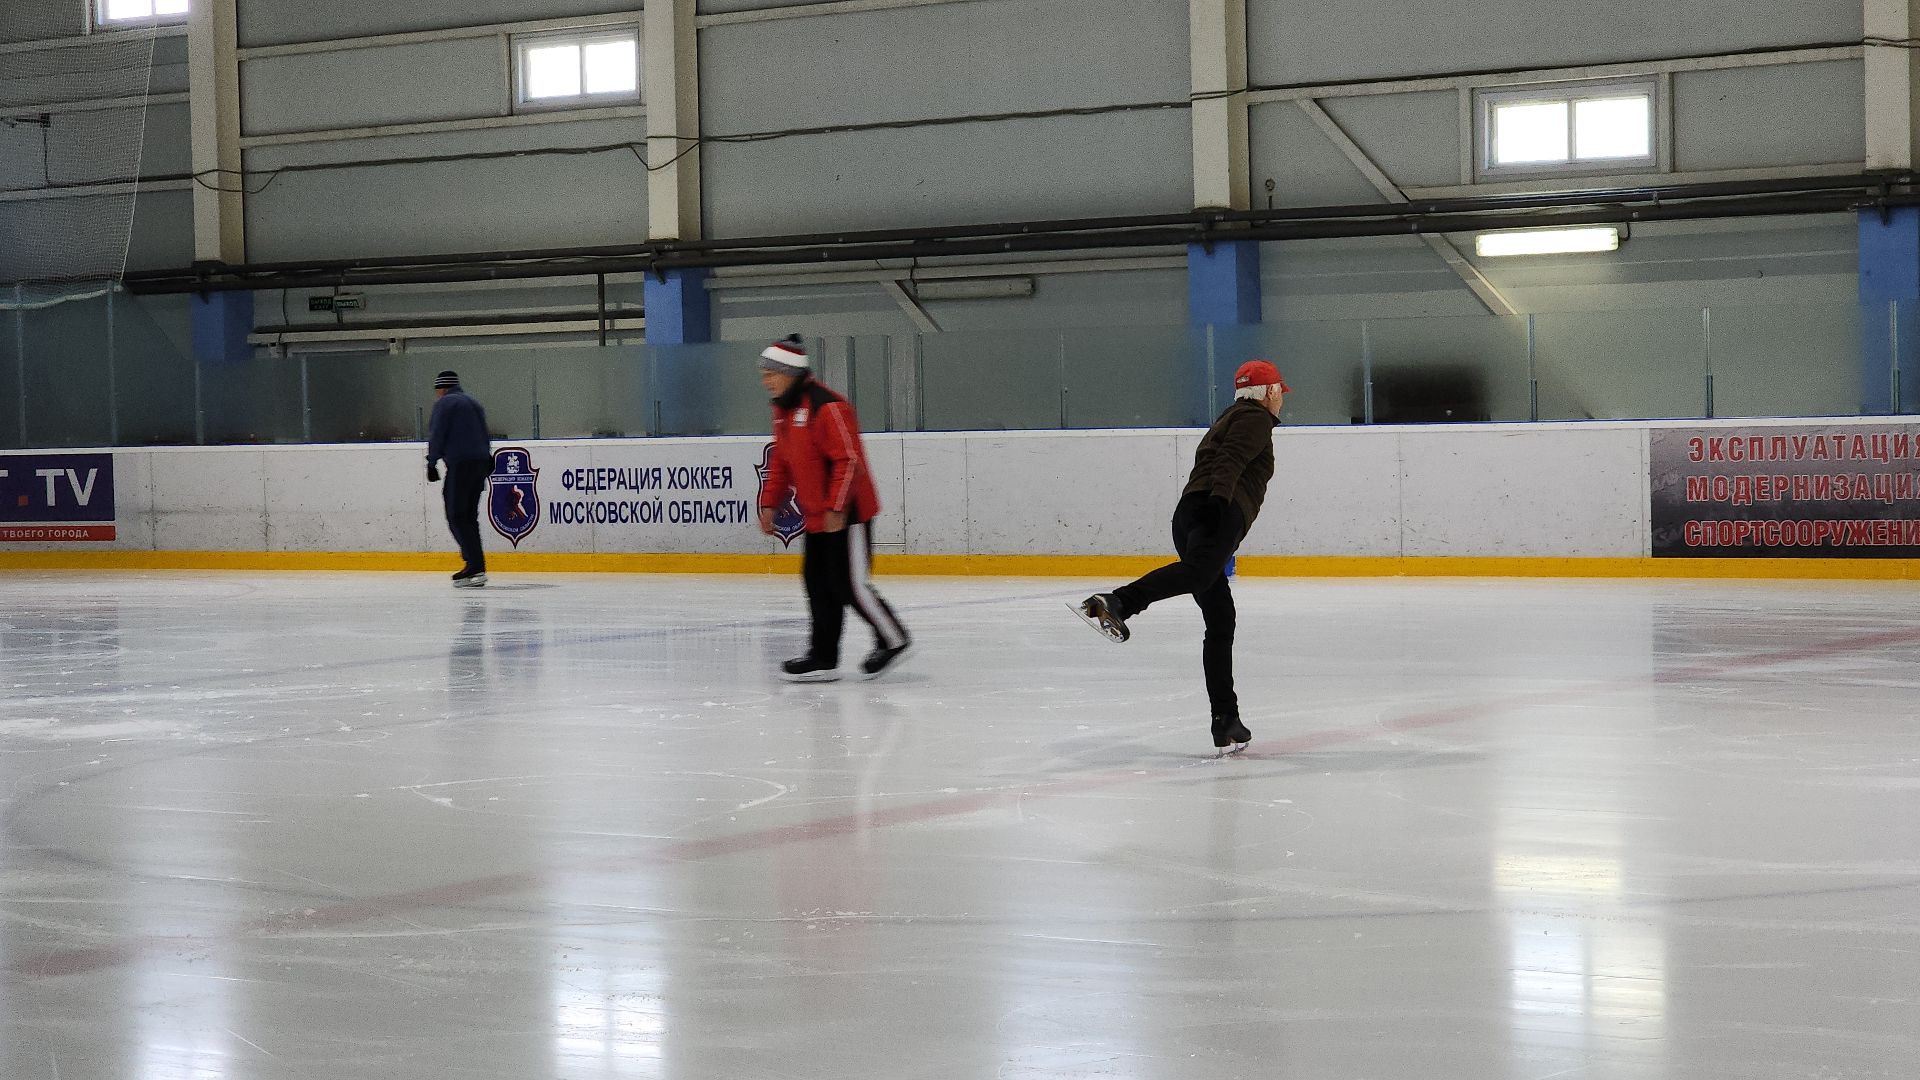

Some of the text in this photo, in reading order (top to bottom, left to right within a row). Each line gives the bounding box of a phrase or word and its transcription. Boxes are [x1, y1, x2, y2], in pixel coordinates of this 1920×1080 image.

[561, 466, 732, 495] ФЕДЕРАЦИЯ ХОККЕЯ
[1686, 473, 1920, 506] МОДЕРНИЗАЦИ
[549, 496, 748, 524] МОСКОВСКОЙ ОБЛАСТИ
[3, 529, 89, 538] ТВОЕГО ГОРОДА
